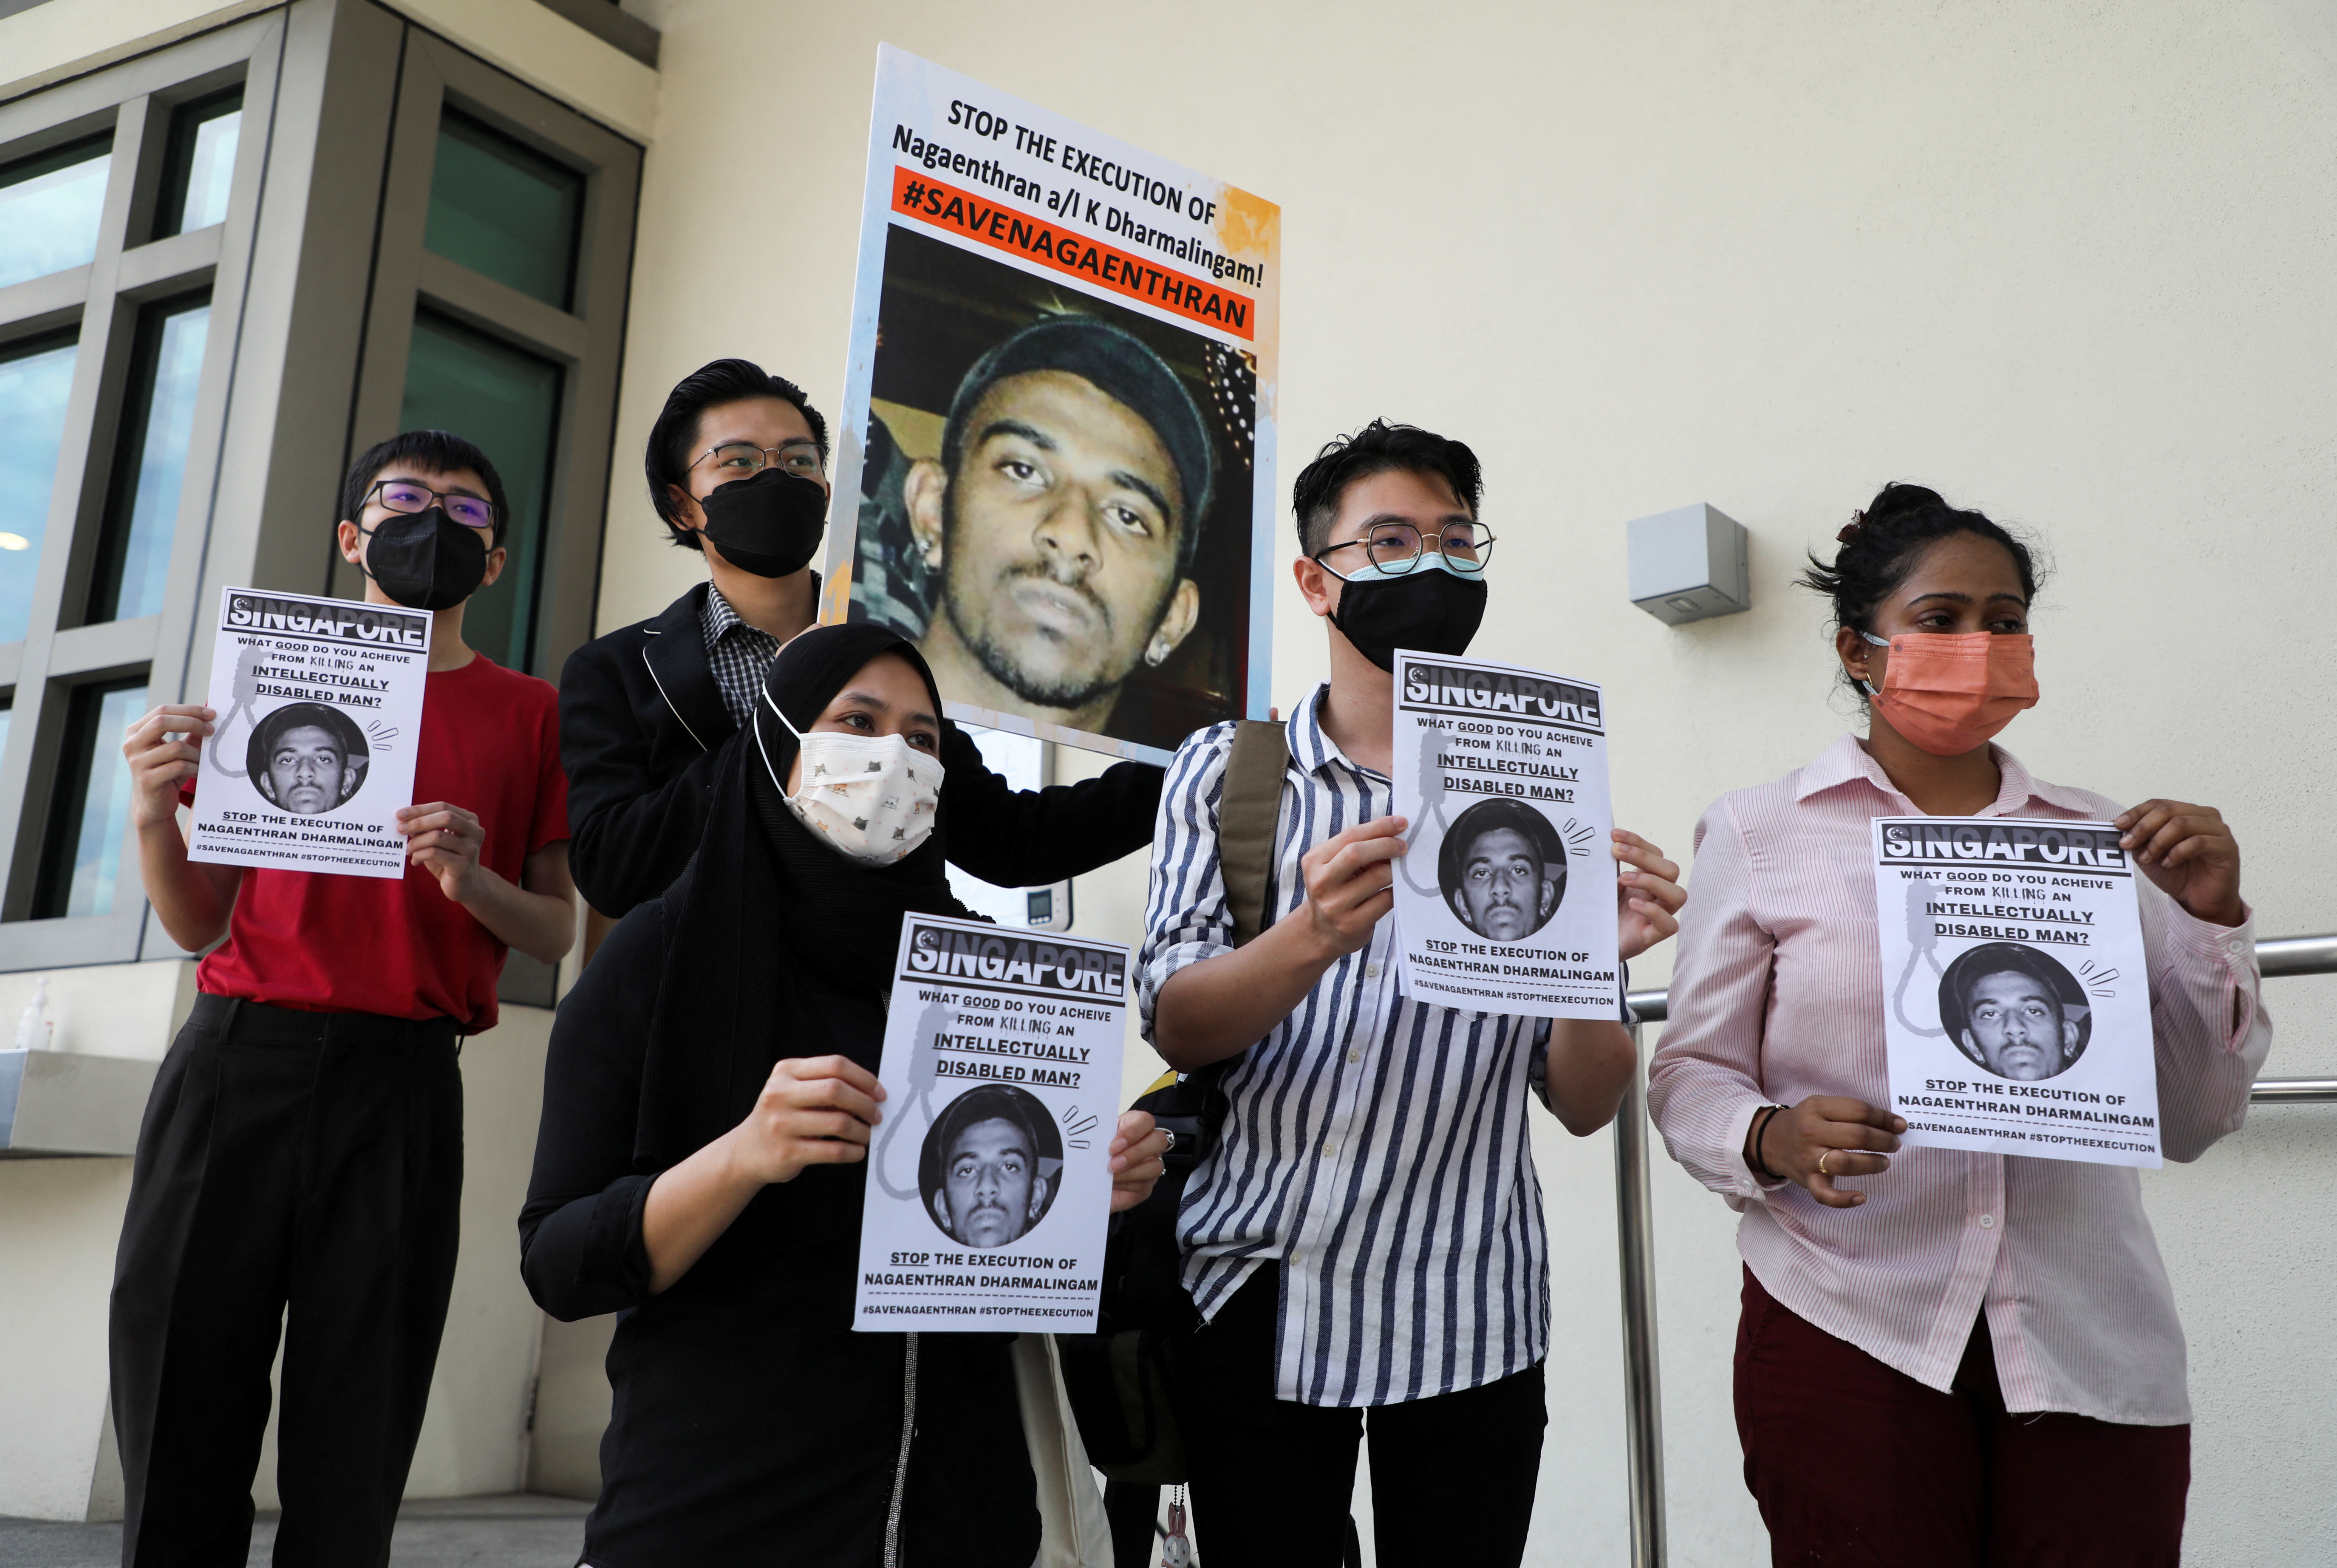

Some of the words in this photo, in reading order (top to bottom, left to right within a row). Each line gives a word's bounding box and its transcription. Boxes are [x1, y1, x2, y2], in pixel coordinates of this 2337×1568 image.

[948, 100, 1007, 141] STOP
[1016, 125, 1056, 163] THE
[1062, 145, 1182, 213] EXECUTION
[1189, 197, 1216, 224] OF
[893, 125, 1041, 203] Nagaenthran
[1086, 199, 1101, 226] K
[1106, 207, 1263, 288] Dharmalingam!
[903, 181, 1246, 328] #SAVENAGAENTHRAN
[231, 598, 423, 645] SINGAPORE
[238, 637, 272, 646] WHAT
[276, 642, 308, 651] GOOD
[334, 648, 356, 657] YOU
[361, 652, 410, 663] ACHEIVE
[272, 654, 304, 663] FROM
[311, 657, 353, 671] KILLING
[253, 665, 389, 689] INTELLECTUALLY
[256, 684, 333, 700] DISABLED
[339, 693, 381, 706] MAN?
[1407, 668, 1598, 725] SINGAPORE
[1417, 718, 1454, 729] WHAT
[1458, 722, 1493, 733] GOOD
[1498, 726, 1513, 735] DO
[1518, 728, 1542, 739] YOU
[1547, 732, 1592, 747] ACHEIVE
[1456, 738, 1490, 749] FROM
[1497, 740, 1540, 756] KILLING
[1546, 748, 1561, 757] AN
[1438, 754, 1578, 779] INTELLECTUALLY
[1444, 777, 1524, 795] DISABLED
[1531, 786, 1573, 800] MAN?
[223, 812, 257, 821] STOP
[261, 815, 286, 824] THE
[291, 818, 363, 831] EXECUTION
[198, 824, 297, 839] NAGAENTHRAN
[302, 833, 403, 849] DHARMALINGAM
[1887, 827, 2122, 866] SINGAPORE
[197, 845, 298, 858] #SAVENAGAENTHRAN
[301, 855, 399, 867] #STOPTHEEXECUTION
[1901, 871, 1941, 879] WHAT
[1947, 872, 1987, 880] GOOD
[1993, 874, 2011, 882] DO
[2017, 875, 2046, 884] YOU
[2052, 878, 2113, 889] ACHEIVE
[1945, 887, 1985, 896] FROM
[1993, 887, 2045, 901] KILLING
[2053, 893, 2071, 901] AN
[1927, 903, 2093, 923] INTELLECTUALLY
[1935, 923, 2029, 939] DISABLED
[2036, 930, 2088, 943] MAN?
[912, 929, 1123, 994] SINGAPORE
[1426, 940, 1457, 951] STOP
[1461, 944, 1486, 955] THE
[1491, 946, 1566, 961] EXECUTION
[1572, 953, 1589, 962] OF
[1409, 954, 1499, 974] NAGAENTHRAN
[1504, 965, 1614, 981] DHARMALINGAM
[1415, 980, 1503, 998] #SAVENAGAENTHRAN
[1506, 992, 1613, 1005] #STOPTHEEXECUTION
[920, 991, 959, 1004] WHAT
[963, 996, 1000, 1008] GOOD
[1004, 1000, 1023, 1011] DO
[1028, 1003, 1055, 1015] YOU
[1060, 1007, 1111, 1022] ACHEIVE
[958, 1014, 994, 1027] FROM
[1000, 1016, 1050, 1035] KILLING
[1056, 1026, 1074, 1036] AN
[934, 1033, 1090, 1061] INTELLECTUALLY
[936, 1060, 1025, 1080] DISABLED
[1032, 1069, 1080, 1086] MAN?
[1926, 1080, 1966, 1090] STOP
[1972, 1083, 2003, 1094] THE
[2009, 1086, 2099, 1103] EXECUTION
[2106, 1095, 2125, 1105] OF
[1899, 1096, 2020, 1114] NAGAENTHRAN
[2026, 1106, 2154, 1127] DHARMALINGAM
[1908, 1122, 2025, 1139] SAVENAGAENTHRAN
[2030, 1134, 2155, 1152] #STOPTHEEXECUTION
[891, 1252, 929, 1263] STOP
[935, 1254, 963, 1265] THE
[968, 1255, 1053, 1268] EXECUTION
[1059, 1259, 1077, 1269] OF
[865, 1274, 975, 1286] NAGAENTHRAN
[981, 1276, 1098, 1290] DHARMALINGAM
[863, 1306, 976, 1314] #SAVENAGAENTHRAN
[980, 1307, 1093, 1316] #STOPTHEEXECUTION
